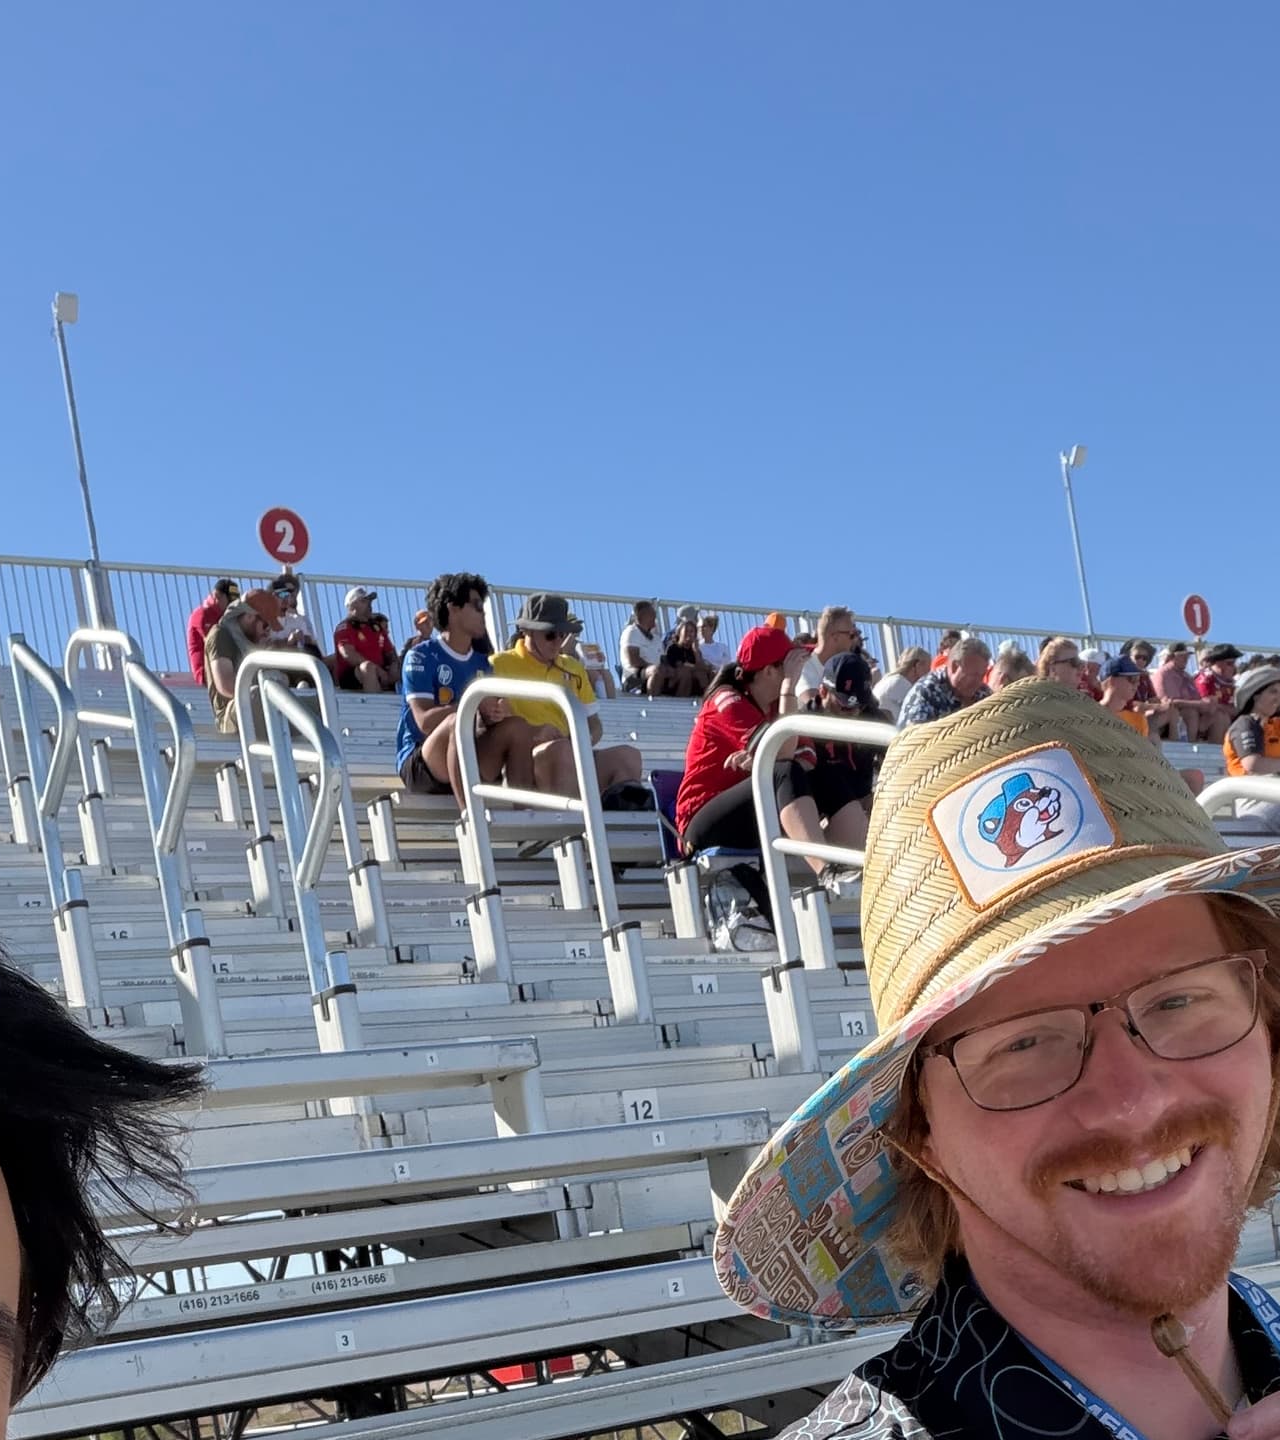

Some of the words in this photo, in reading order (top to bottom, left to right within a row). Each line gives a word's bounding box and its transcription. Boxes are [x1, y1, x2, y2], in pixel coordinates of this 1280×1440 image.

[275, 519, 296, 554] 2
[1193, 603, 1203, 628] 1
[847, 1020, 865, 1037] 13
[630, 1099, 655, 1121] 12
[398, 1164, 407, 1175] 2
[311, 1279, 338, 1295] (416)
[672, 1281, 681, 1293] 2
[178, 1295, 209, 1313] (416)
[341, 1335, 350, 1347] 3
